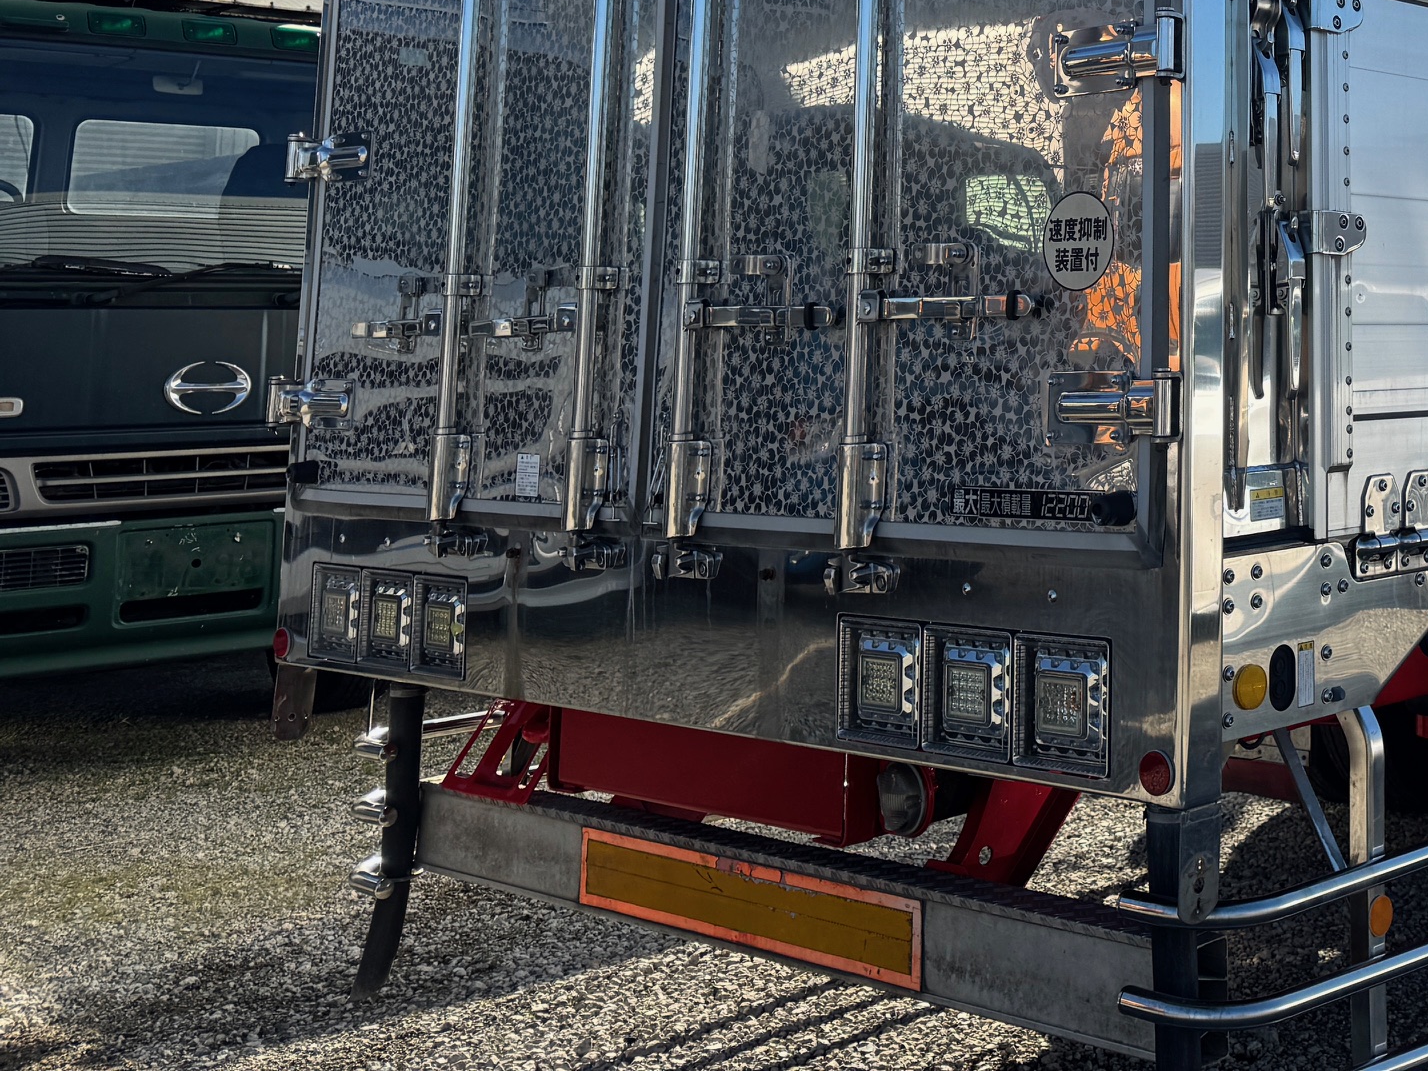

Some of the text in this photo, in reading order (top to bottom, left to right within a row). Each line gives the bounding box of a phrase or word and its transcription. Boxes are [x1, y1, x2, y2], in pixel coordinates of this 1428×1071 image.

[1049, 216, 1108, 243] 速度抑制
[1055, 247, 1100, 272] 装置付
[953, 489, 980, 515] 最大
[981, 492, 1089, 518] 最大積載量 12200
